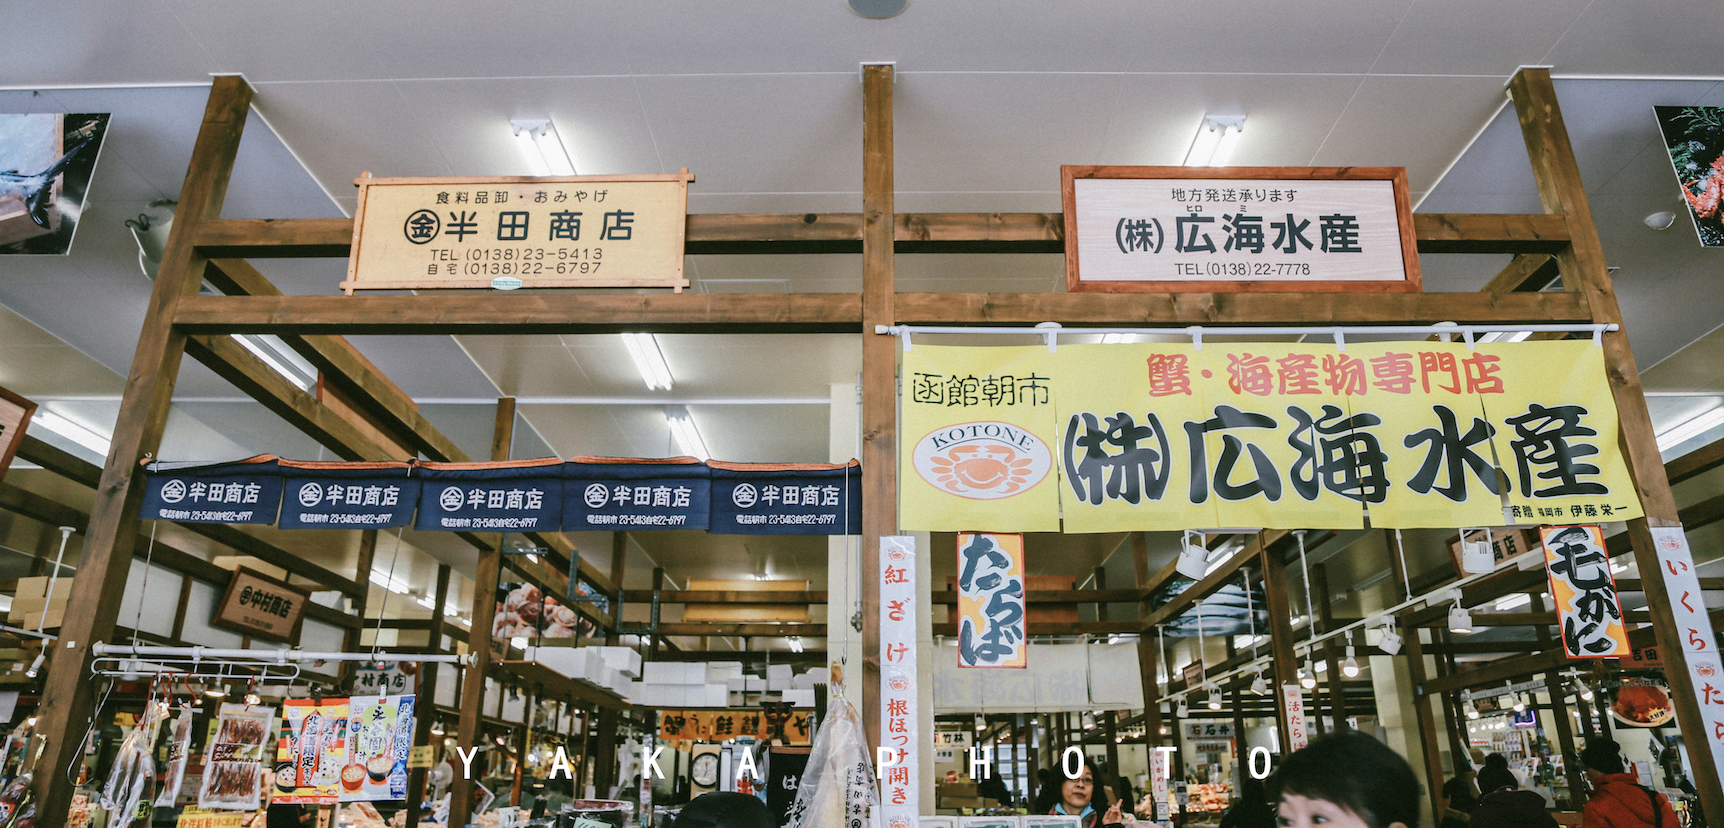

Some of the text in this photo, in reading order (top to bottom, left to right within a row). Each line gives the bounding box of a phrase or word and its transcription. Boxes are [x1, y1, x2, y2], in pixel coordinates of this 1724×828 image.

[436, 189, 609, 205] 食料品卸・おみやげ
[1171, 188, 1298, 203] 地方発送承ります
[431, 248, 603, 261] TEL (0138)23-5413
[463, 262, 602, 275] (0138)22-6797
[913, 372, 1051, 408] 函館朝市
[1147, 352, 1504, 397] 蟹・海産物専門店
[930, 423, 1035, 452] KOTONE
[959, 533, 1024, 666] たらば
[1549, 527, 1621, 656] 毛がに
[1666, 559, 1706, 650] いくら
[885, 565, 910, 664] 紅ざけ
